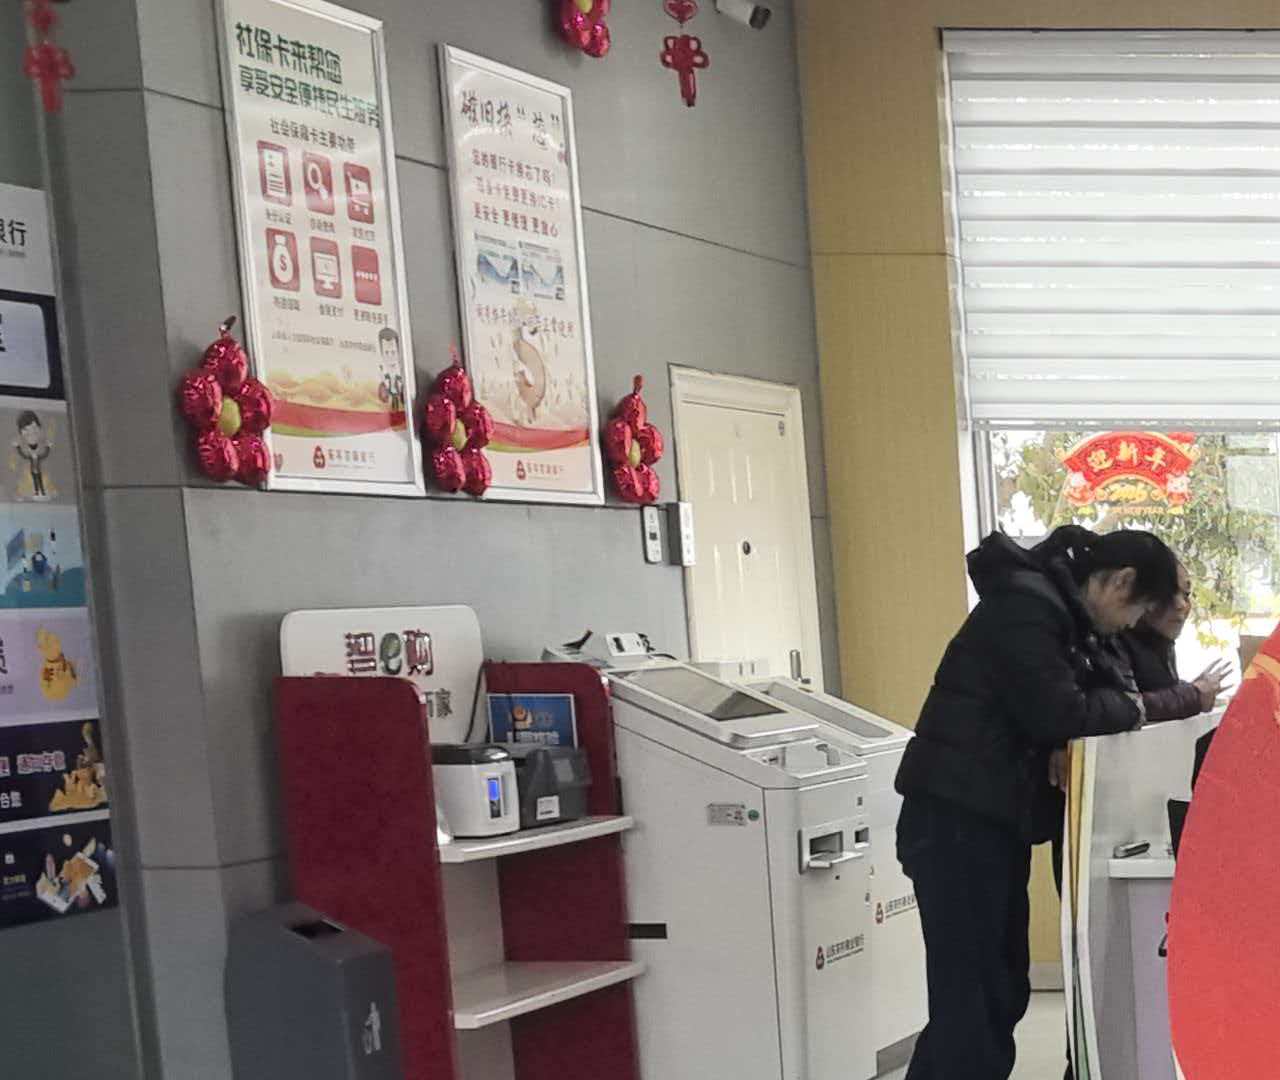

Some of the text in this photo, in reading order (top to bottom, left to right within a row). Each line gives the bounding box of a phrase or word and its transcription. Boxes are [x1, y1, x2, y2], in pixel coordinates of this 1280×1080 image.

[236, 22, 342, 84] 社保卡来帮您
[239, 65, 380, 128] 享受安全便捷民生服务
[1087, 440, 1166, 473] 迎新年
